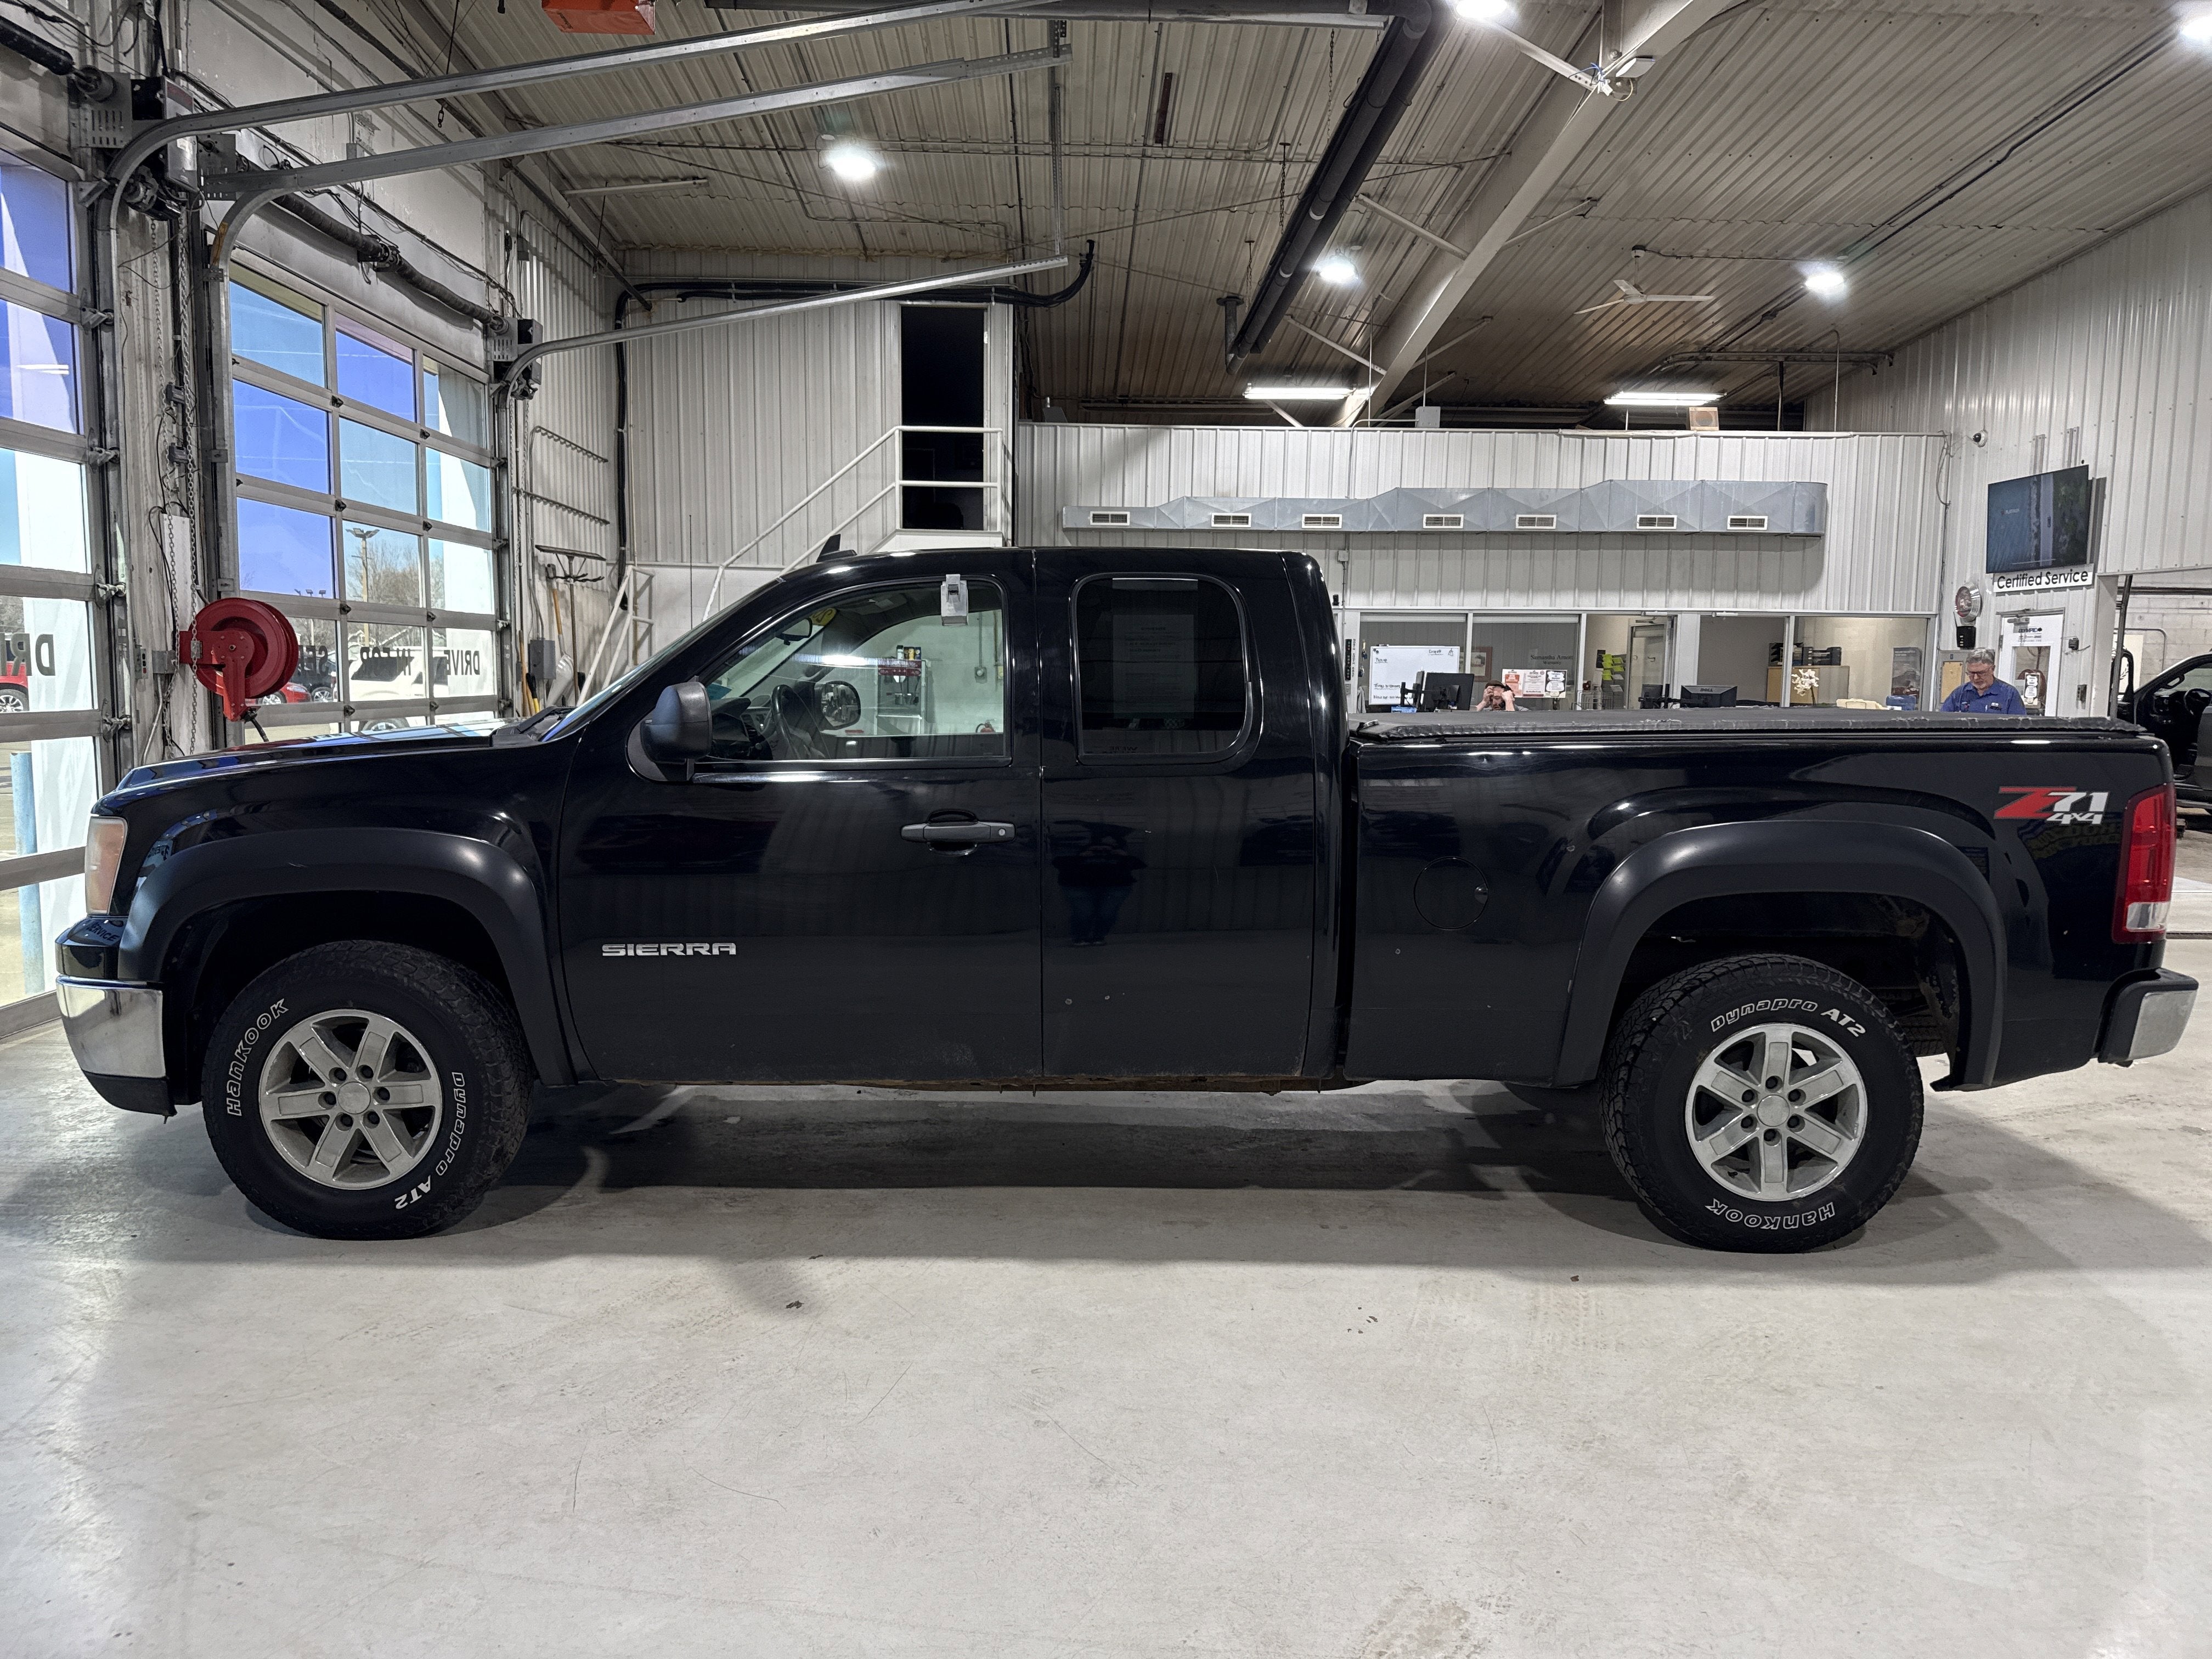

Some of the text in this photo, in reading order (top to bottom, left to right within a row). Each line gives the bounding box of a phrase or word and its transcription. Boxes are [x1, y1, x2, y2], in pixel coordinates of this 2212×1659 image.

[1997, 568, 2089, 589] Certified Service
[1994, 787, 2109, 819] Z71
[602, 942, 737, 956] SIERRA
[1820, 1008, 1866, 1037] AT2
[394, 1175, 432, 1210] AT2
